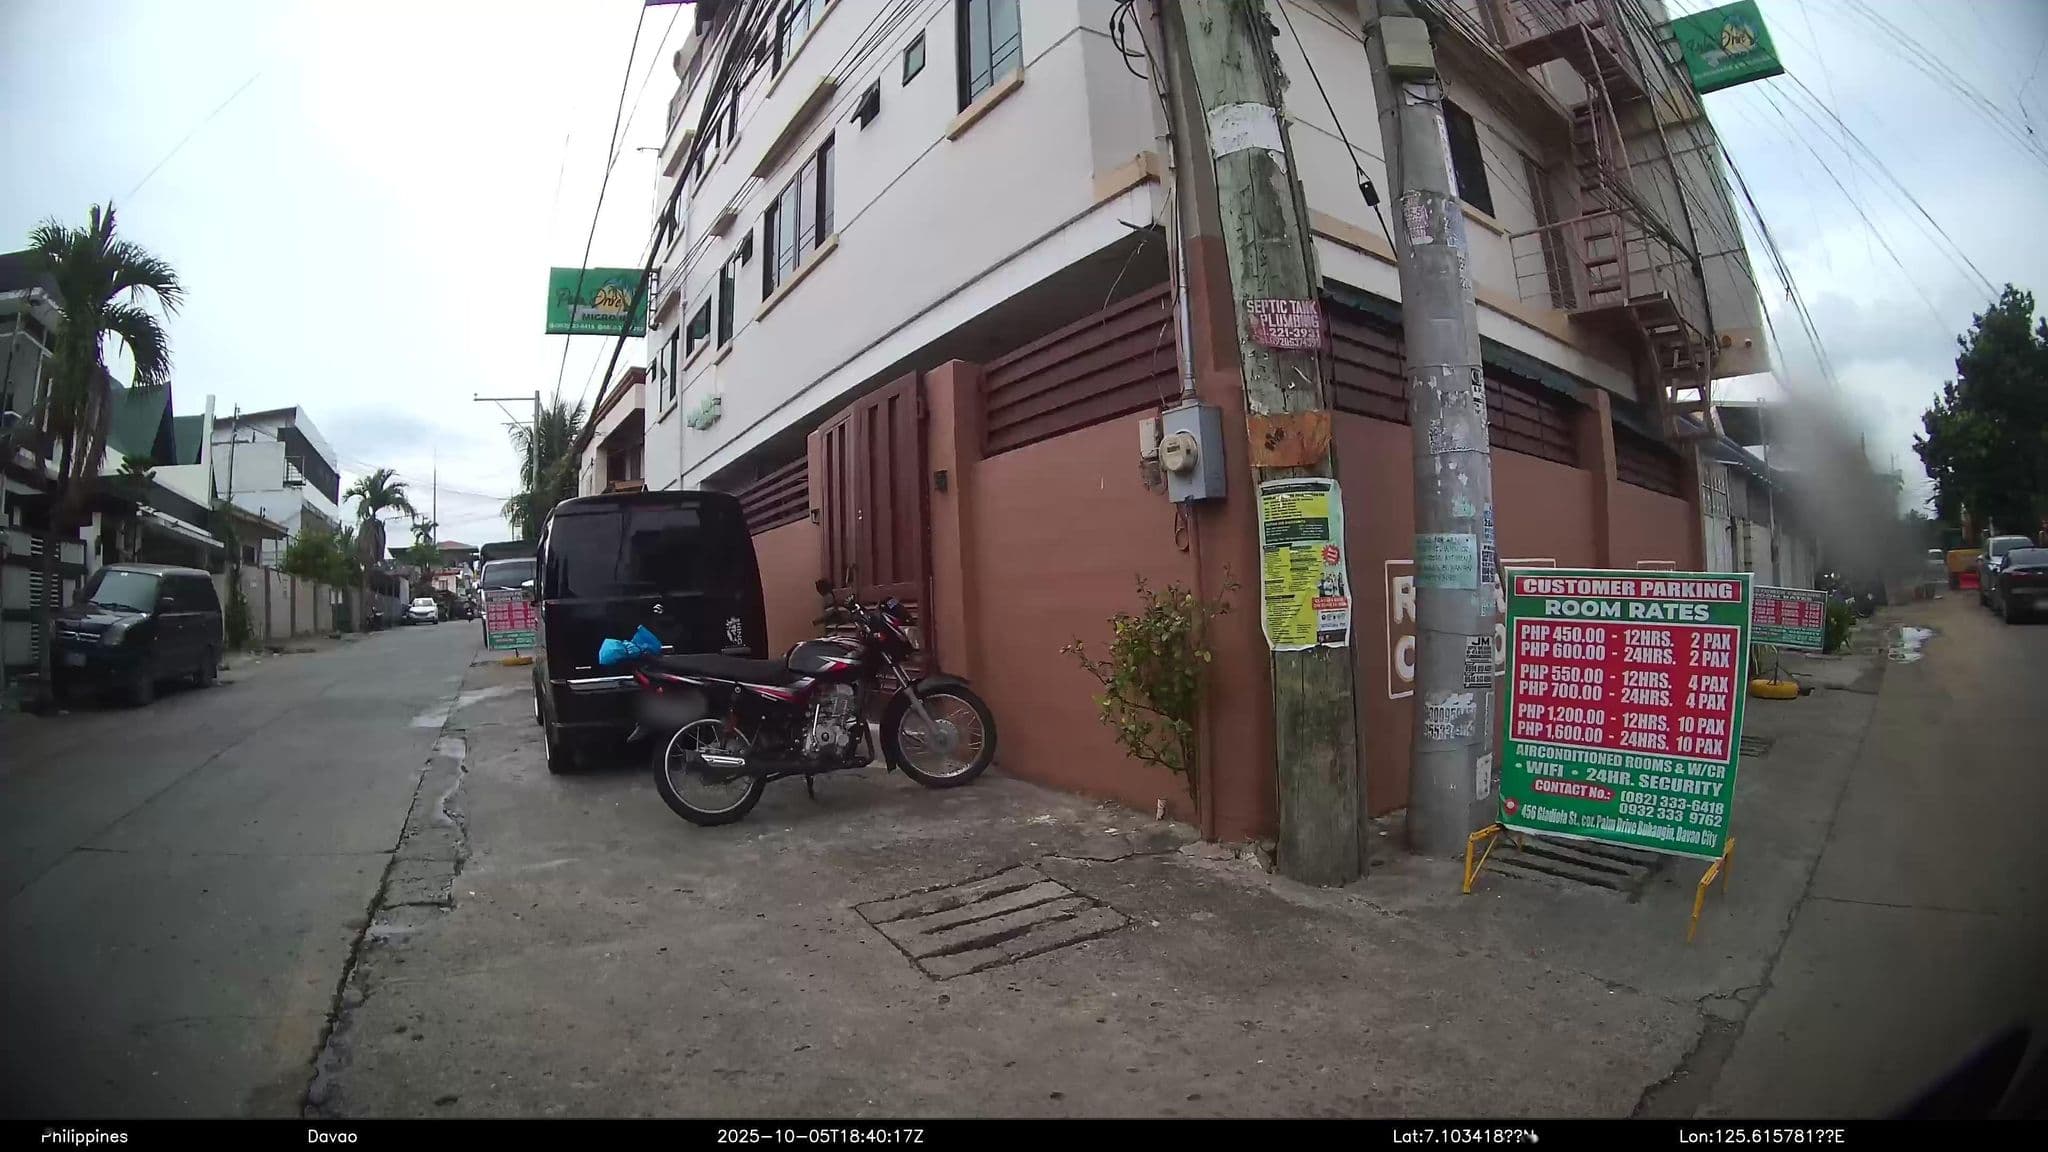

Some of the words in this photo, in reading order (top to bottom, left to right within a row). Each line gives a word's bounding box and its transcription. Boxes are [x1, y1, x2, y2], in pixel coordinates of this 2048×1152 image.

[1246, 299, 1288, 314] SEPTIC
[1289, 300, 1318, 314] TANK
[1260, 313, 1320, 329] PLUMBING
[1523, 579, 1635, 597] CUSTOMER
[1641, 580, 1732, 599] PARKING
[1545, 600, 1621, 618] ROOM
[1629, 601, 1709, 622] RATES
[1471, 637, 1490, 646] JM
[1521, 625, 1550, 641] PHP
[1553, 626, 1605, 644] 450.00
[1624, 629, 1675, 647] 12HRS.
[1691, 633, 1700, 649] 2
[1704, 633, 1731, 650] PAX
[1520, 642, 1549, 658] PHP
[1553, 643, 1605, 661] 600.00
[1623, 647, 1676, 665] 24HRS.
[1690, 650, 1699, 667] 2
[1703, 651, 1730, 668] PAX
[1520, 664, 1549, 680] PHP
[1551, 666, 1604, 684] 550.00
[1622, 671, 1672, 689] 12HRS.
[1688, 674, 1699, 691] 4
[1701, 675, 1729, 693] PAX
[1519, 680, 1548, 697] PHP
[1551, 683, 1602, 701] 700.00
[1621, 688, 1673, 707] 24HRS.
[1685, 692, 1696, 709] 4
[1699, 693, 1726, 711] PAX
[1518, 703, 1544, 720] PHP
[1546, 705, 1605, 725] 1,200.00
[1622, 712, 1670, 732] 12HRS.
[1678, 716, 1694, 733] 10
[1697, 717, 1725, 736] PAX
[1517, 720, 1544, 737] PHP
[1545, 723, 1603, 743] 1,600.00
[1620, 730, 1669, 751] 24HRS.
[1676, 735, 1693, 753] 10
[1695, 737, 1723, 755] PAX
[1516, 743, 1623, 767] AIRCONDITIONED
[1625, 755, 1673, 773] ROOMS
[1674, 762, 1685, 775] &
[1687, 762, 1726, 779] W/CR
[1526, 760, 1564, 777] WIFI
[1586, 767, 1635, 786] 24HR.
[1638, 774, 1723, 798] SECURITY
[1535, 779, 1588, 797] CONTACT
[1619, 802, 1655, 818] 0932
[1656, 807, 1684, 822] 333
[1689, 811, 1723, 828] 9762
[1660, 795, 1725, 815] 333-6418
[1521, 804, 1538, 820] 456
[1596, 814, 1616, 832] Palm
[1615, 817, 1637, 835] Drive
[1676, 826, 1701, 845] Davao
[1701, 829, 1718, 848] City
